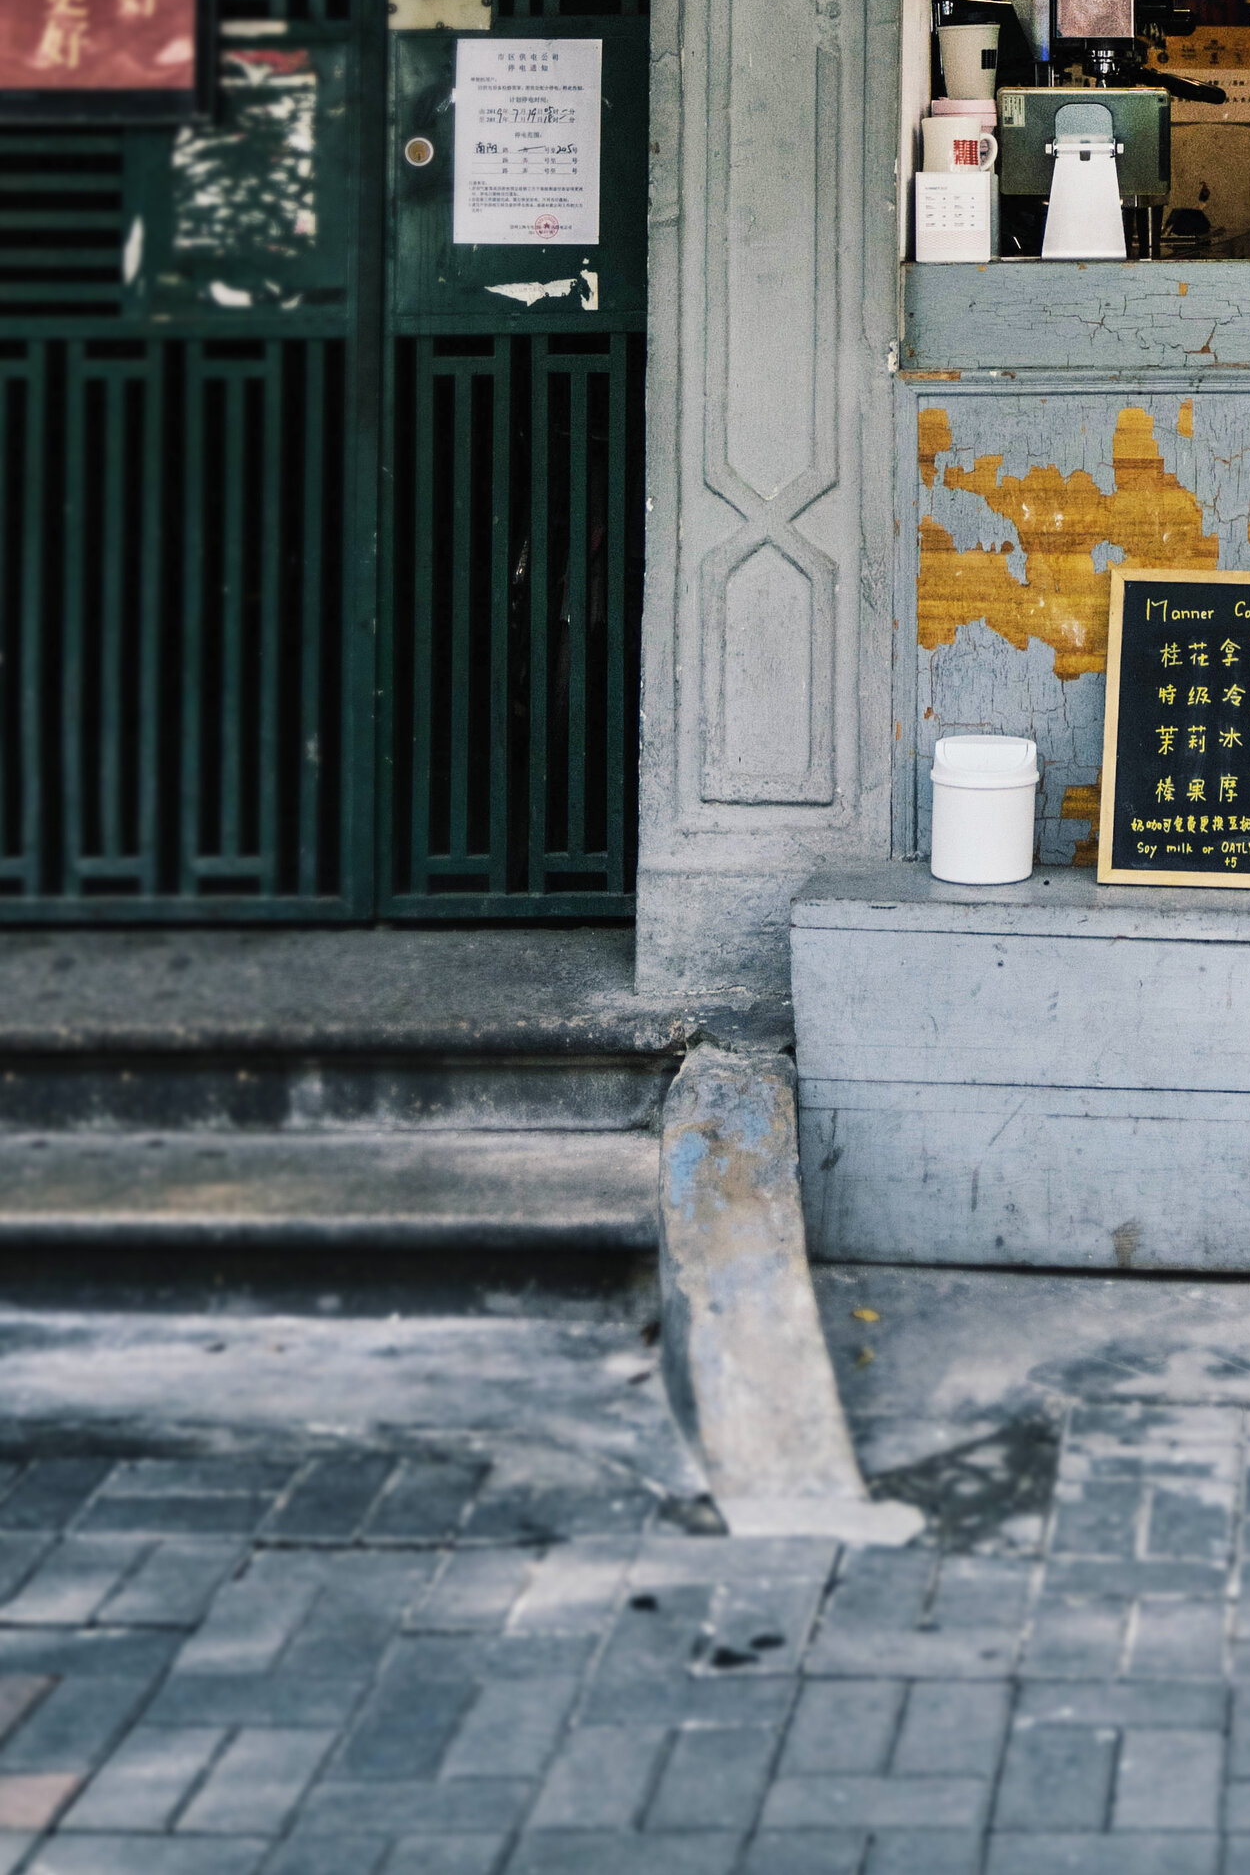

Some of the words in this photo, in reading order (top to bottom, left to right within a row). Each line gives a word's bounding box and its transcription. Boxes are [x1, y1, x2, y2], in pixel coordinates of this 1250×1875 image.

[1146, 599, 1215, 622] Manner
[1137, 842, 1158, 858] Soy
[1166, 842, 1193, 854] milk
[1202, 845, 1214, 854] or
